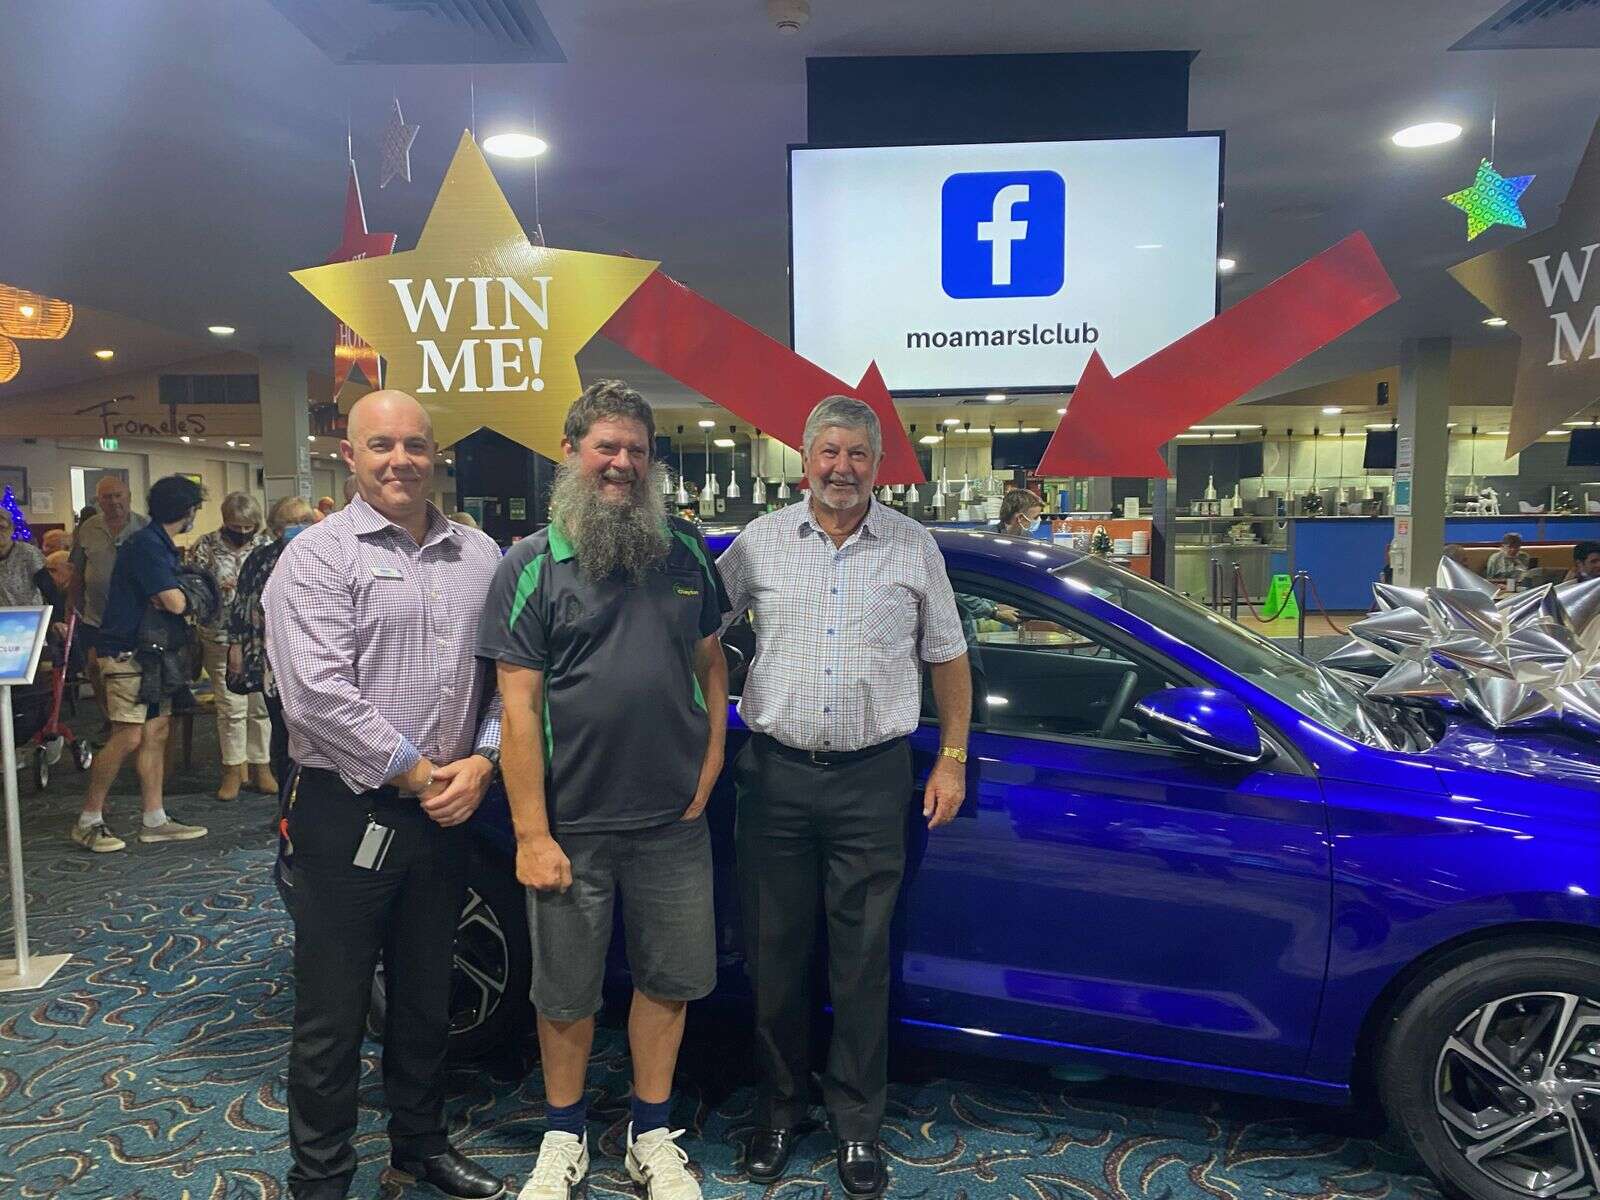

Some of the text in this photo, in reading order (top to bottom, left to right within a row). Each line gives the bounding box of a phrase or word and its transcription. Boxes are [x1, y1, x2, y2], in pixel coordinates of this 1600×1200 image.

[388, 276, 553, 333] WIN
[907, 322, 1099, 349] moamarslclub
[416, 337, 545, 393] ME!
